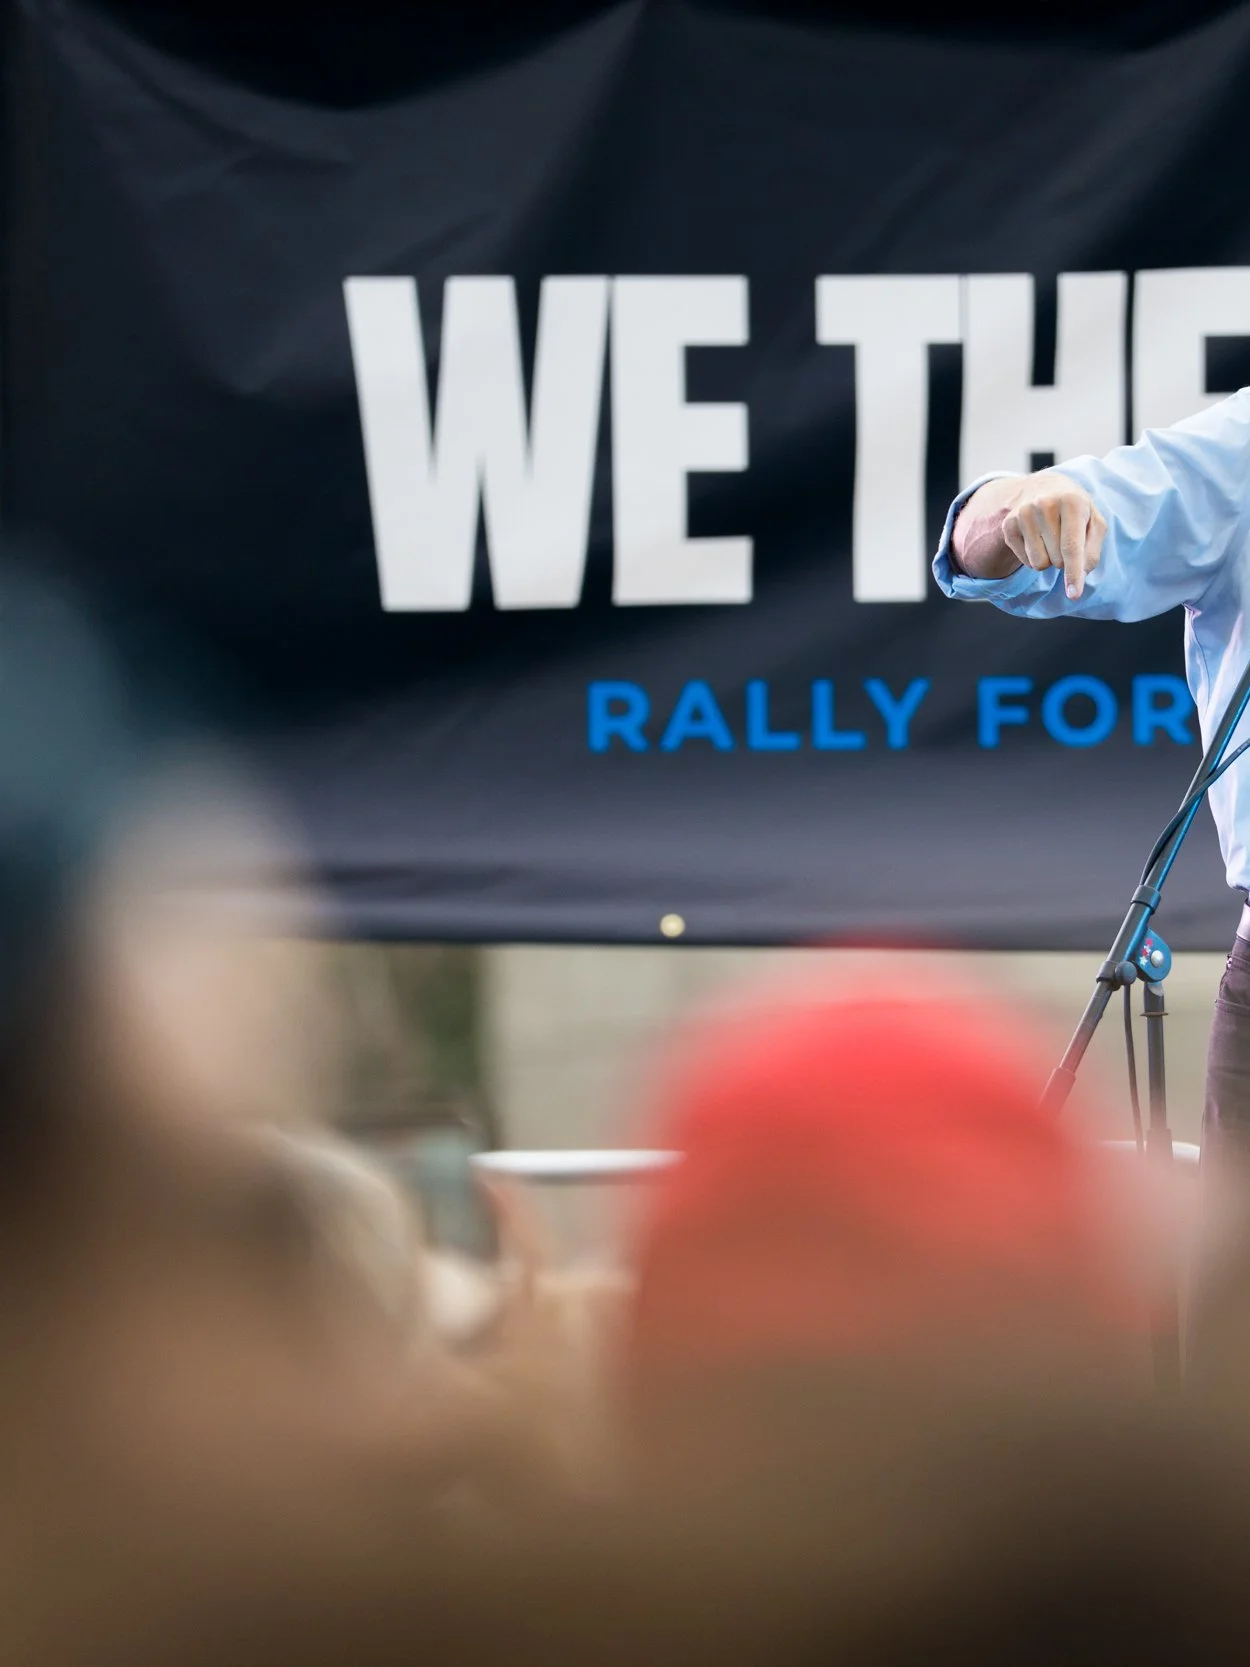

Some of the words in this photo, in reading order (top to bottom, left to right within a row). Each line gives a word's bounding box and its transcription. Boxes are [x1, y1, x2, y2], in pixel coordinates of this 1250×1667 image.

[343, 274, 753, 612] WE
[585, 676, 932, 754] RALLY
[976, 672, 1196, 749] FOR
